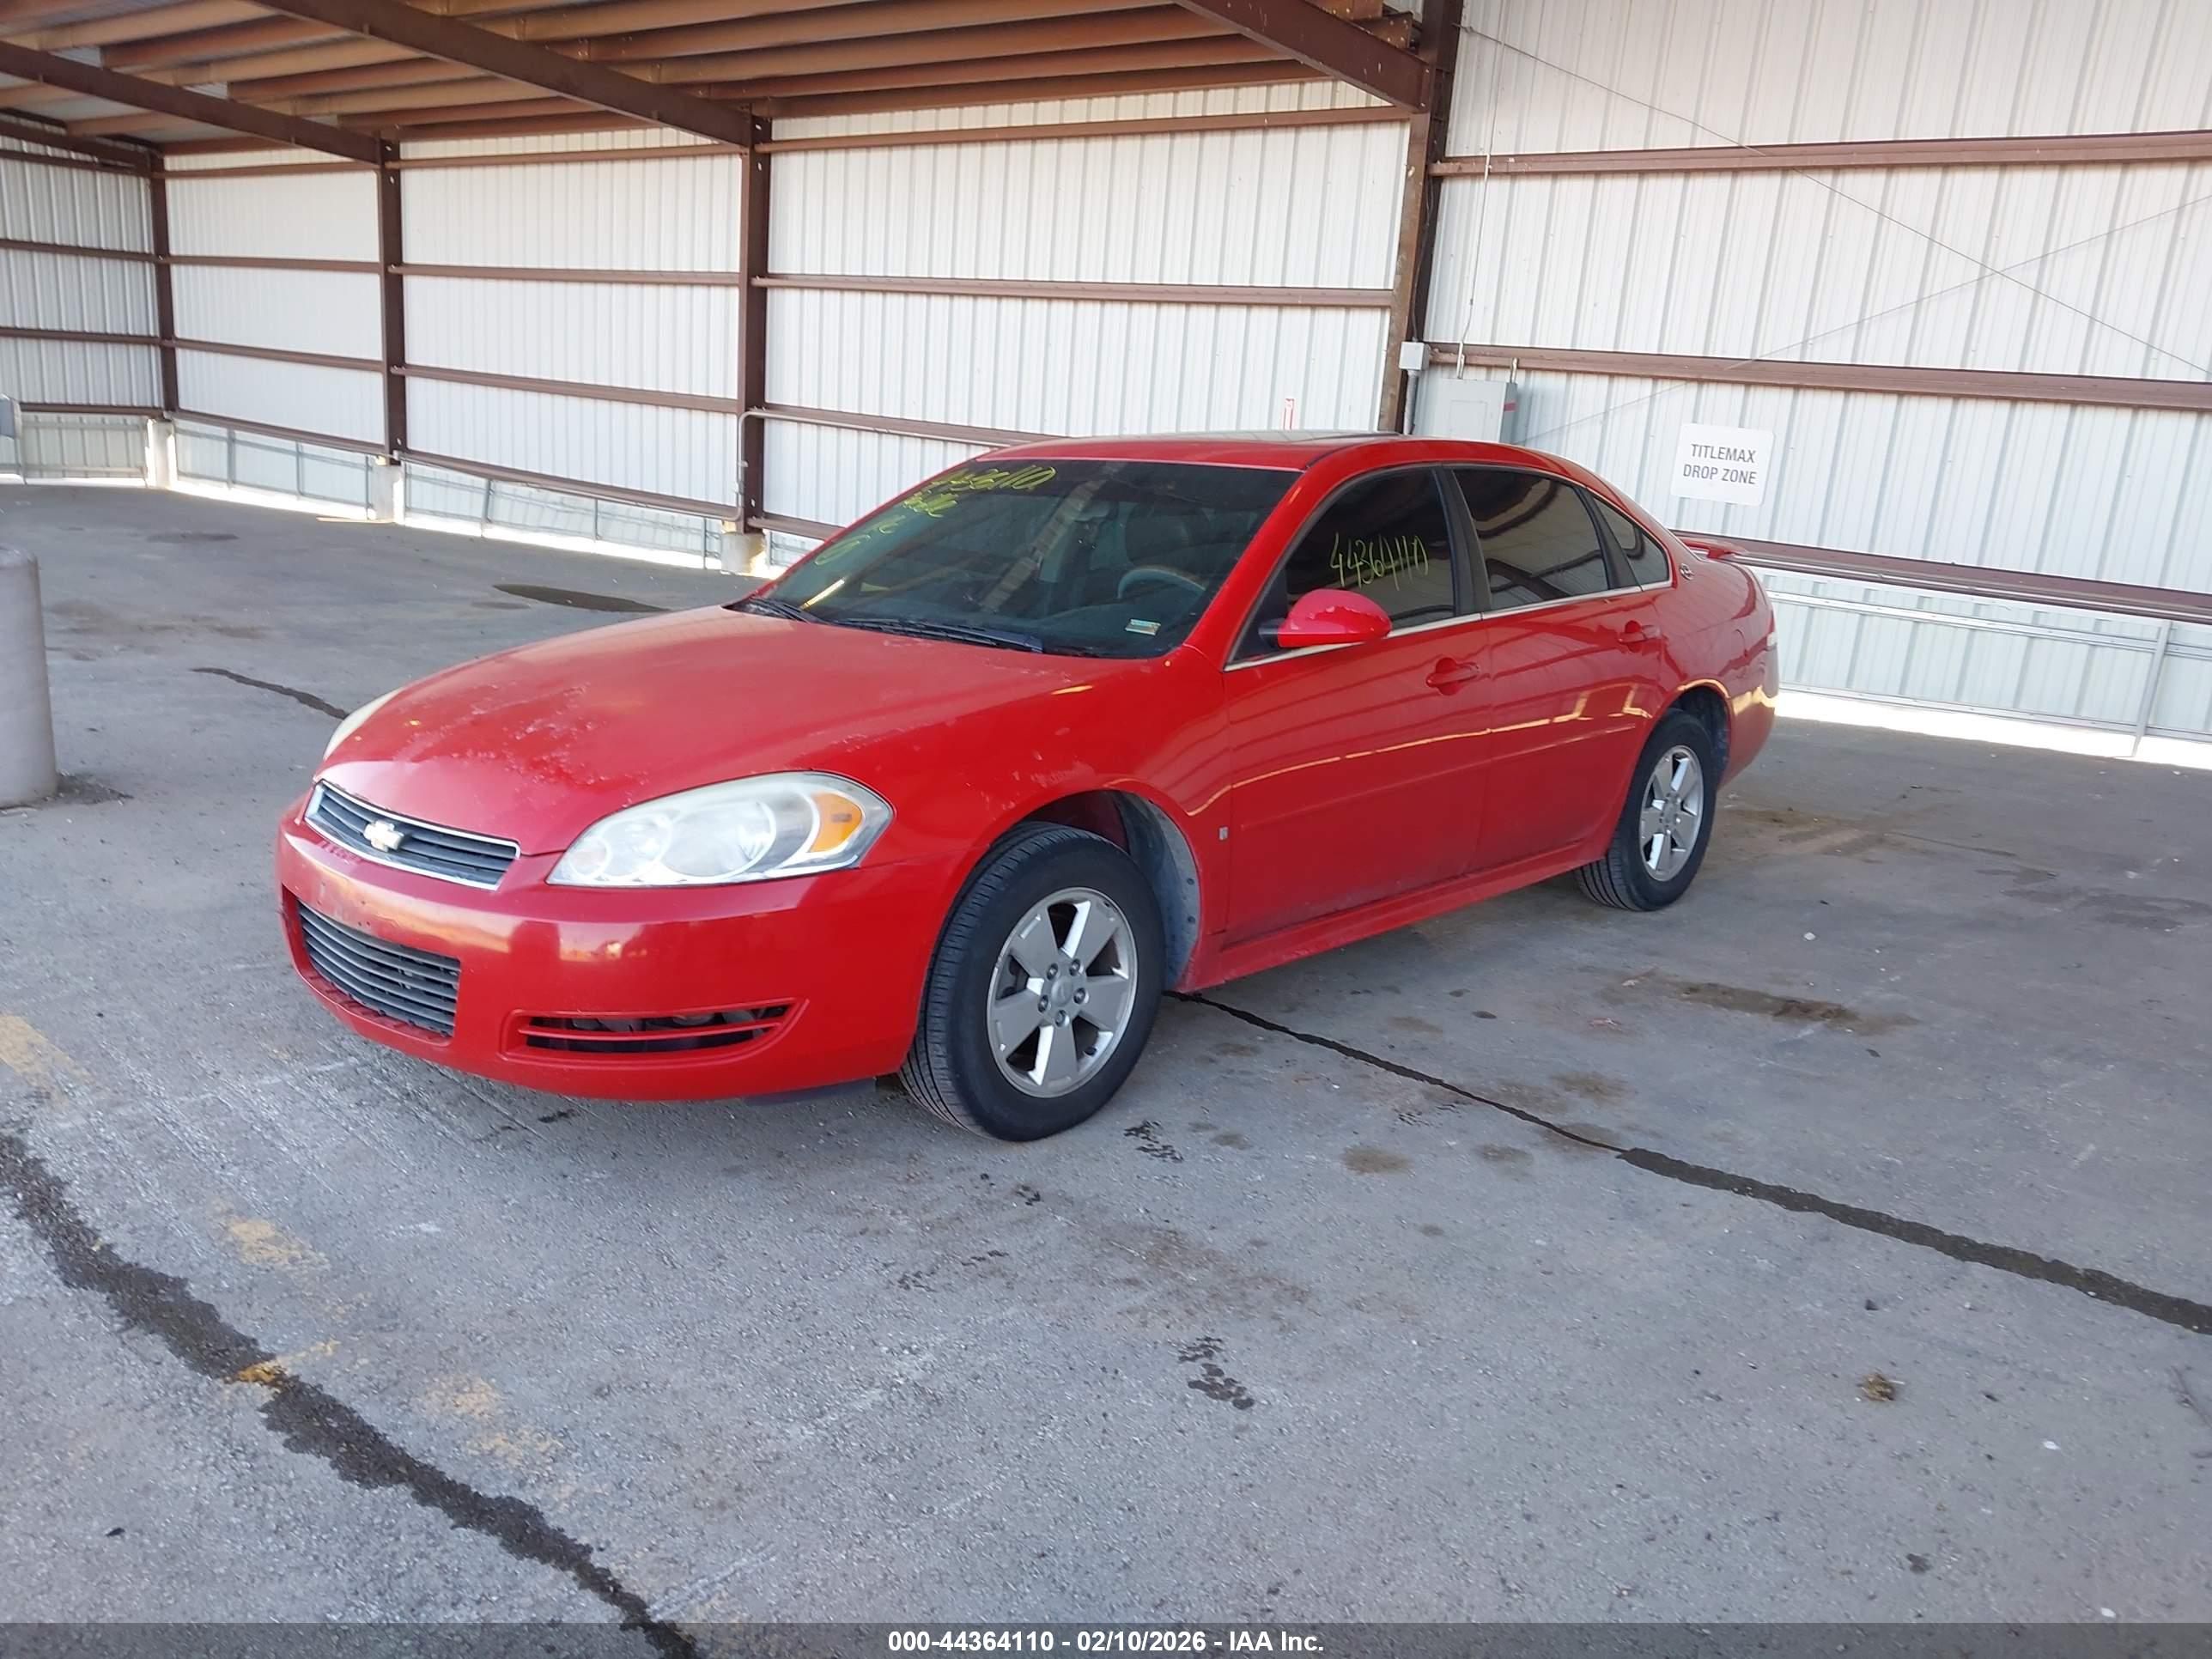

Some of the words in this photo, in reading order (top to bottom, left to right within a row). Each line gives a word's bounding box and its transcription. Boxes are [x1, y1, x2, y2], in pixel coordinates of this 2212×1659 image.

[1692, 444, 1756, 463] TITLEMAX
[1683, 464, 1718, 480] DROP
[1721, 468, 1758, 485] ZONE
[1330, 532, 1429, 592] 44364110
